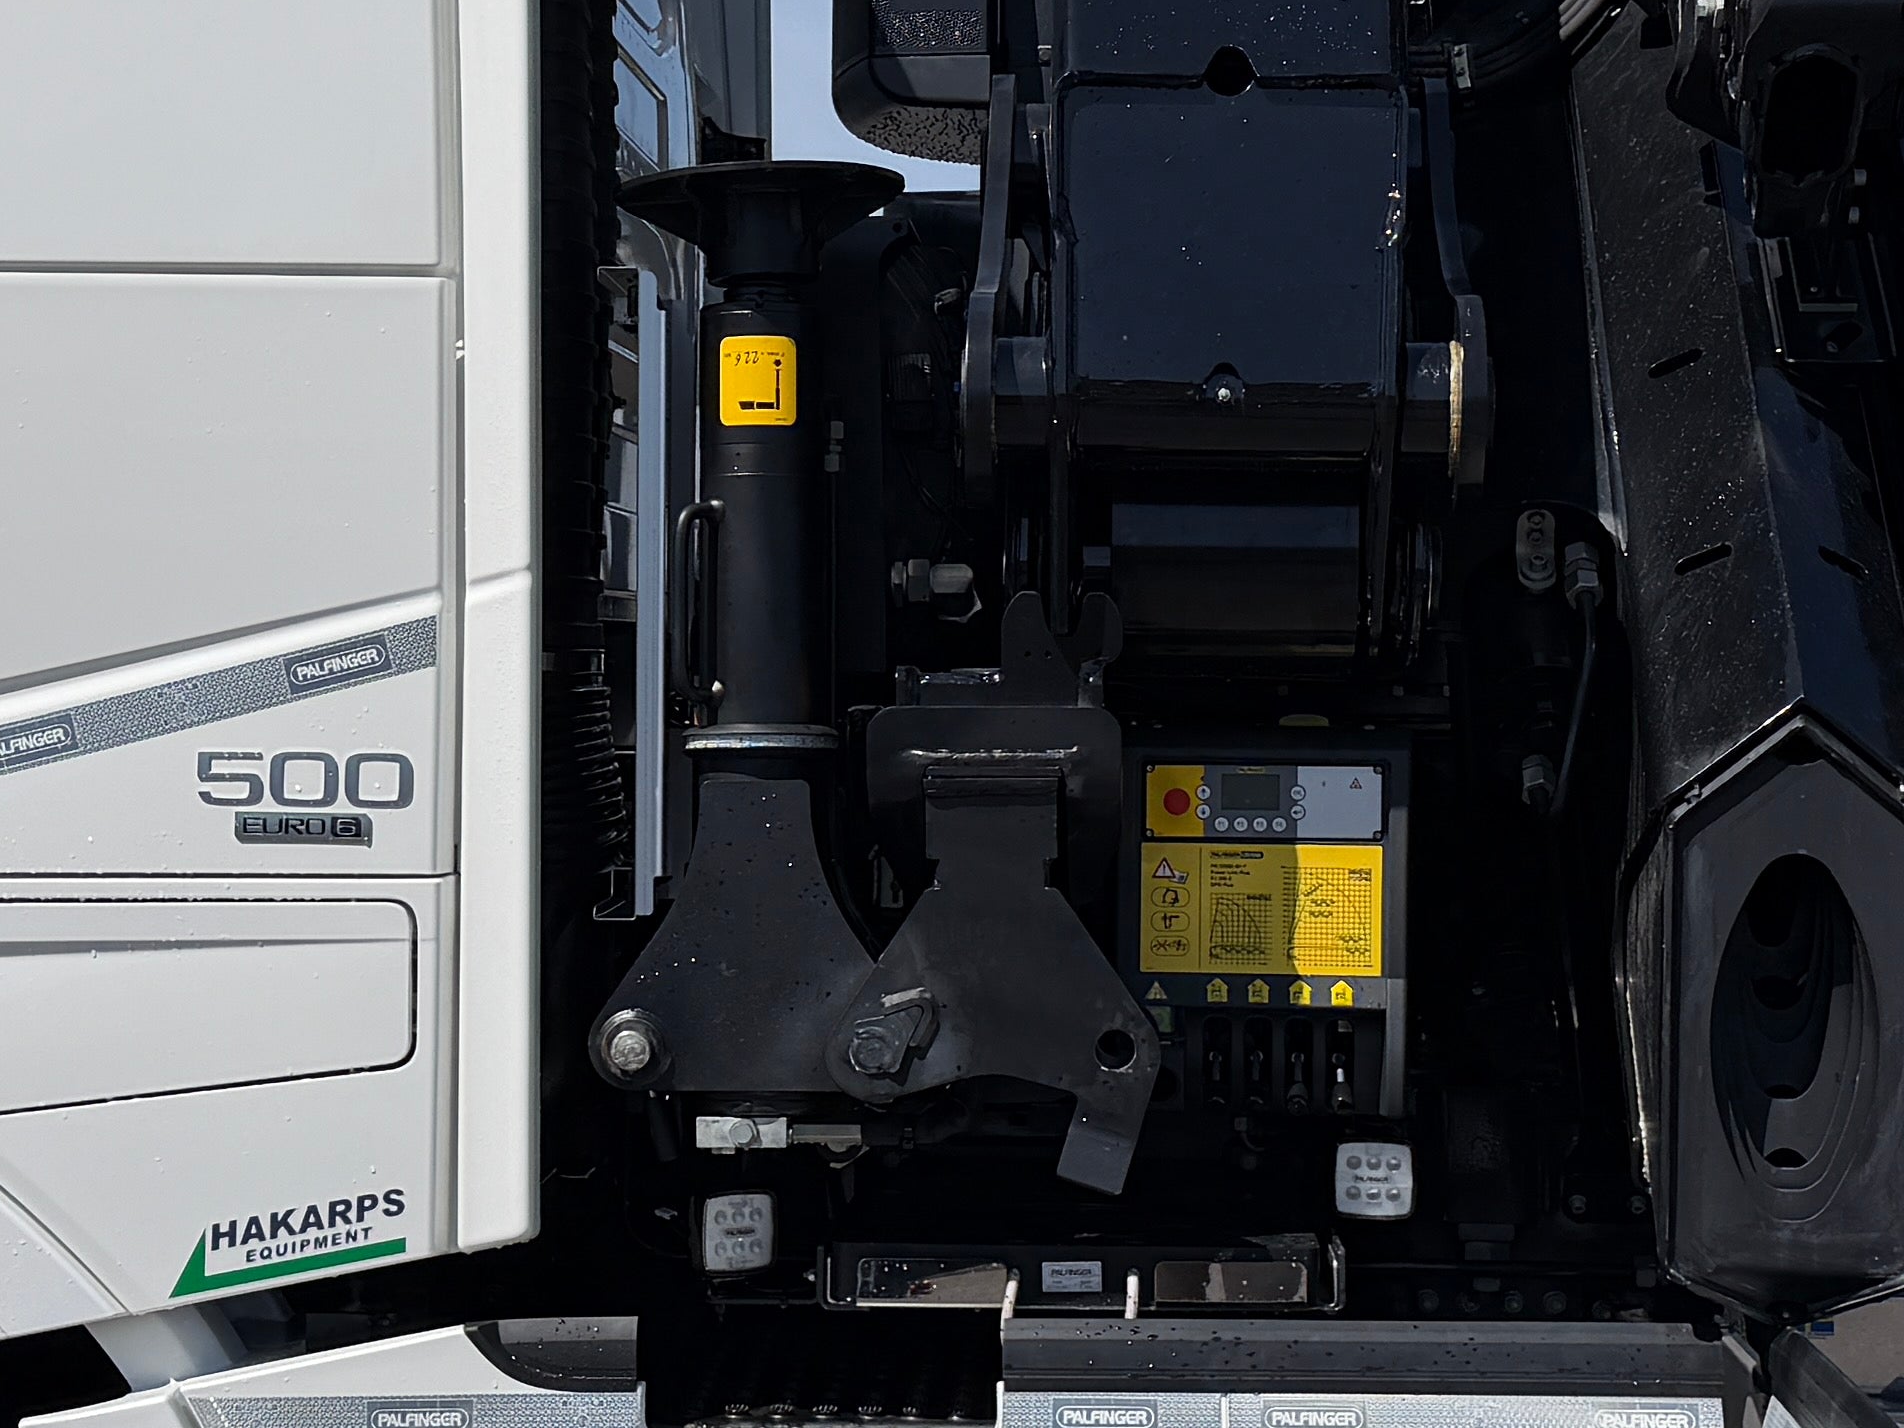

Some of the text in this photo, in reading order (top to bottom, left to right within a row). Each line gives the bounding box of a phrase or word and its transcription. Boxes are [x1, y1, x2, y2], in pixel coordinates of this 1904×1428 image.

[296, 645, 380, 683] PALFINGER
[197, 751, 414, 809] 500
[242, 816, 357, 837] EURO 6
[211, 1189, 405, 1251] HAKARPS
[246, 1227, 372, 1262] EQUIPMENT
[1062, 1408, 1148, 1427] PALFINGER
[1271, 1409, 1357, 1428] PALFINGER
